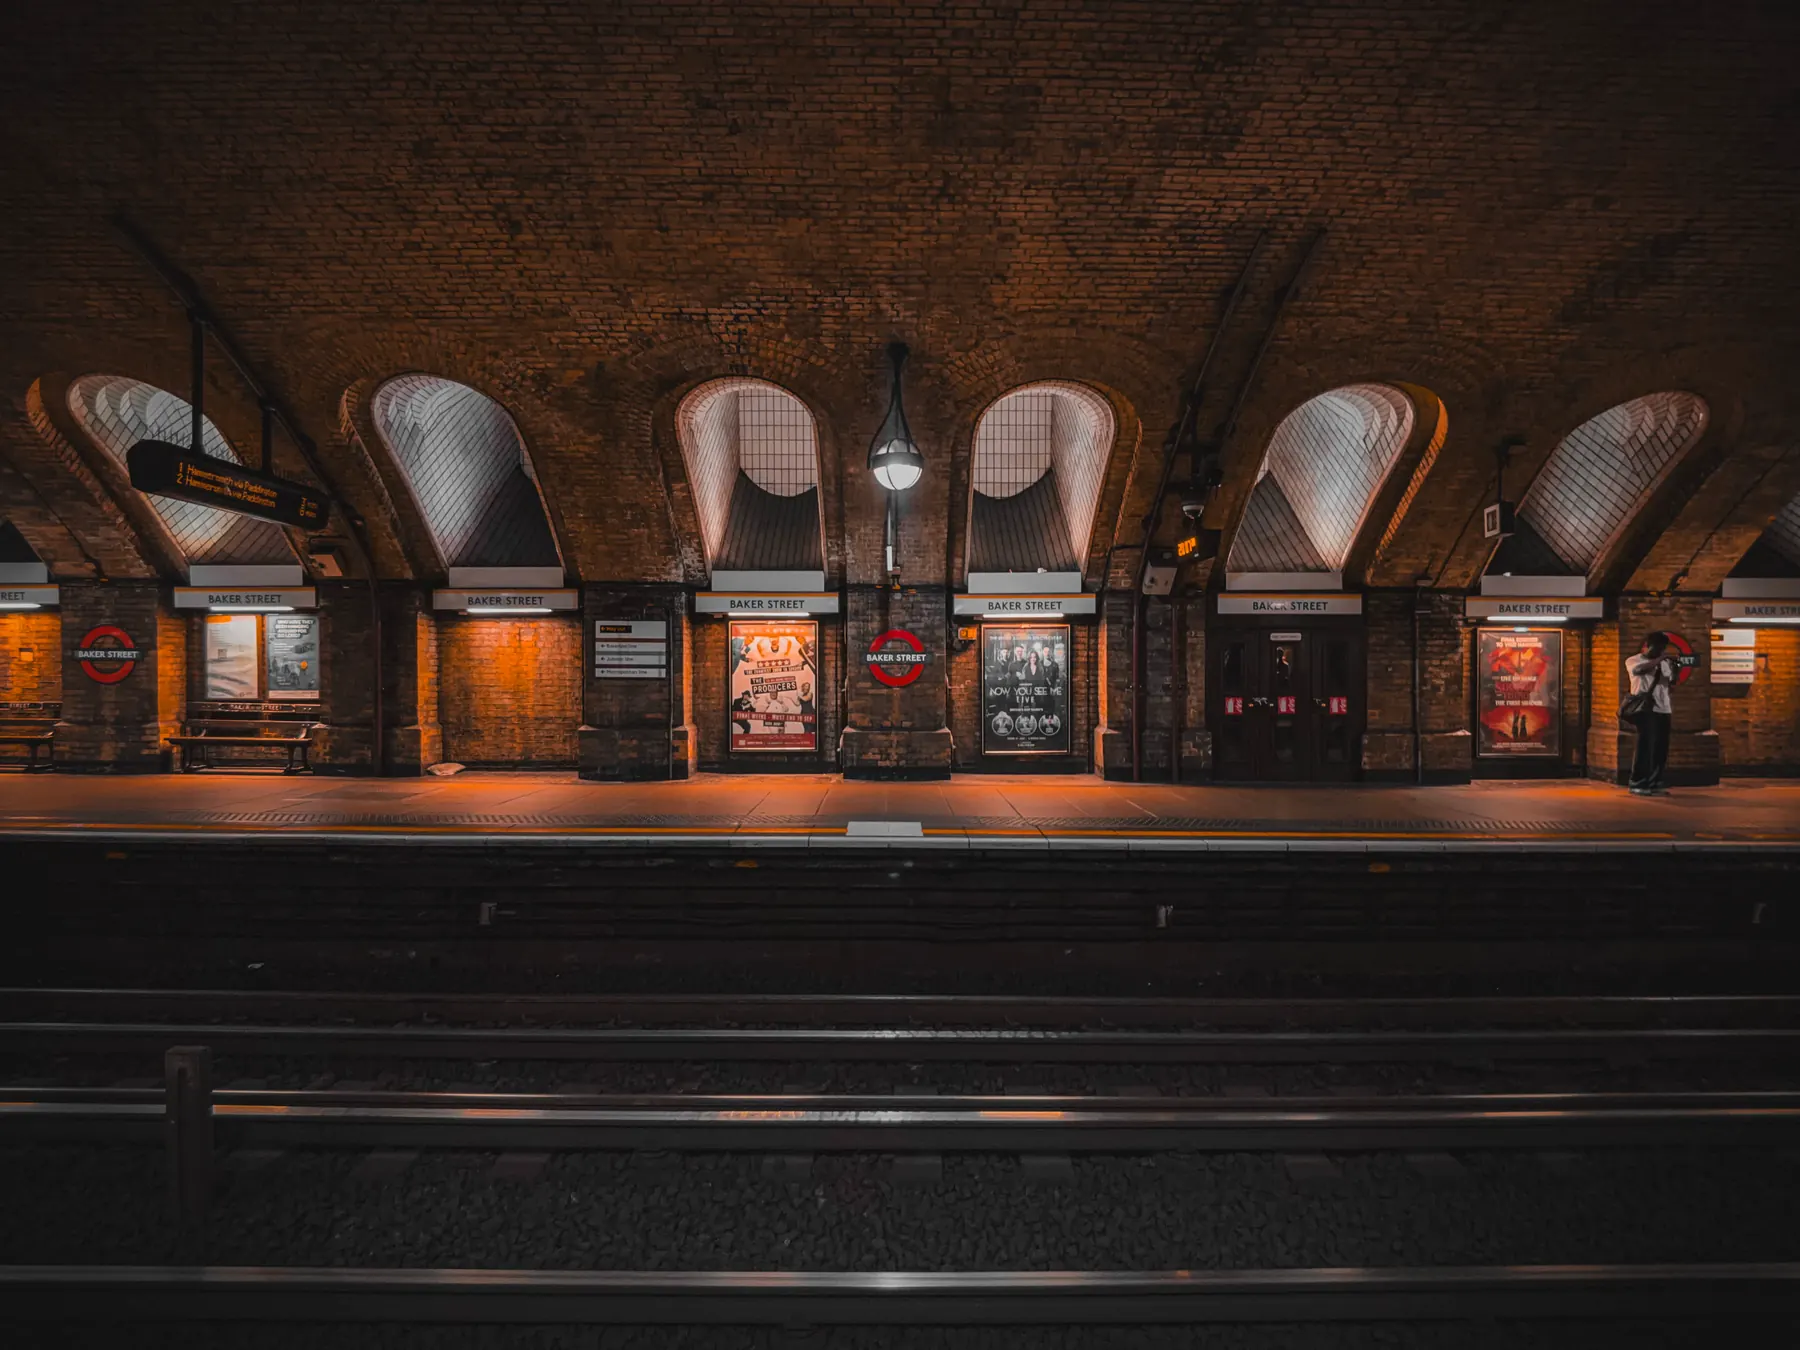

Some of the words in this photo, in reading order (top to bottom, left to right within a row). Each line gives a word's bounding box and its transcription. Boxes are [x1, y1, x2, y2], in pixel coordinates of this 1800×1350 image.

[176, 473, 183, 484] 2
[208, 595, 242, 604] BAKER
[245, 595, 282, 604] STREET
[468, 597, 501, 605] BAKER
[506, 597, 544, 605] STREET
[730, 600, 764, 608] BAKER
[768, 600, 805, 609] STREET
[988, 601, 1021, 610] BAKER
[1025, 601, 1062, 610] STREET
[1252, 602, 1287, 611] BAKER
[1290, 602, 1328, 611] STREET
[1499, 604, 1532, 613] BAKER
[1535, 604, 1571, 613] STREET
[1745, 606, 1776, 615] BAKER
[866, 653, 895, 662] BAKER
[896, 653, 927, 662] STREET
[753, 681, 796, 693] PRODUCERS
[989, 686, 1011, 696] NOW
[1013, 687, 1032, 696] YOU
[1034, 687, 1048, 696] SEE
[1050, 687, 1062, 696] ME
[1016, 696, 1035, 704] LIVE
